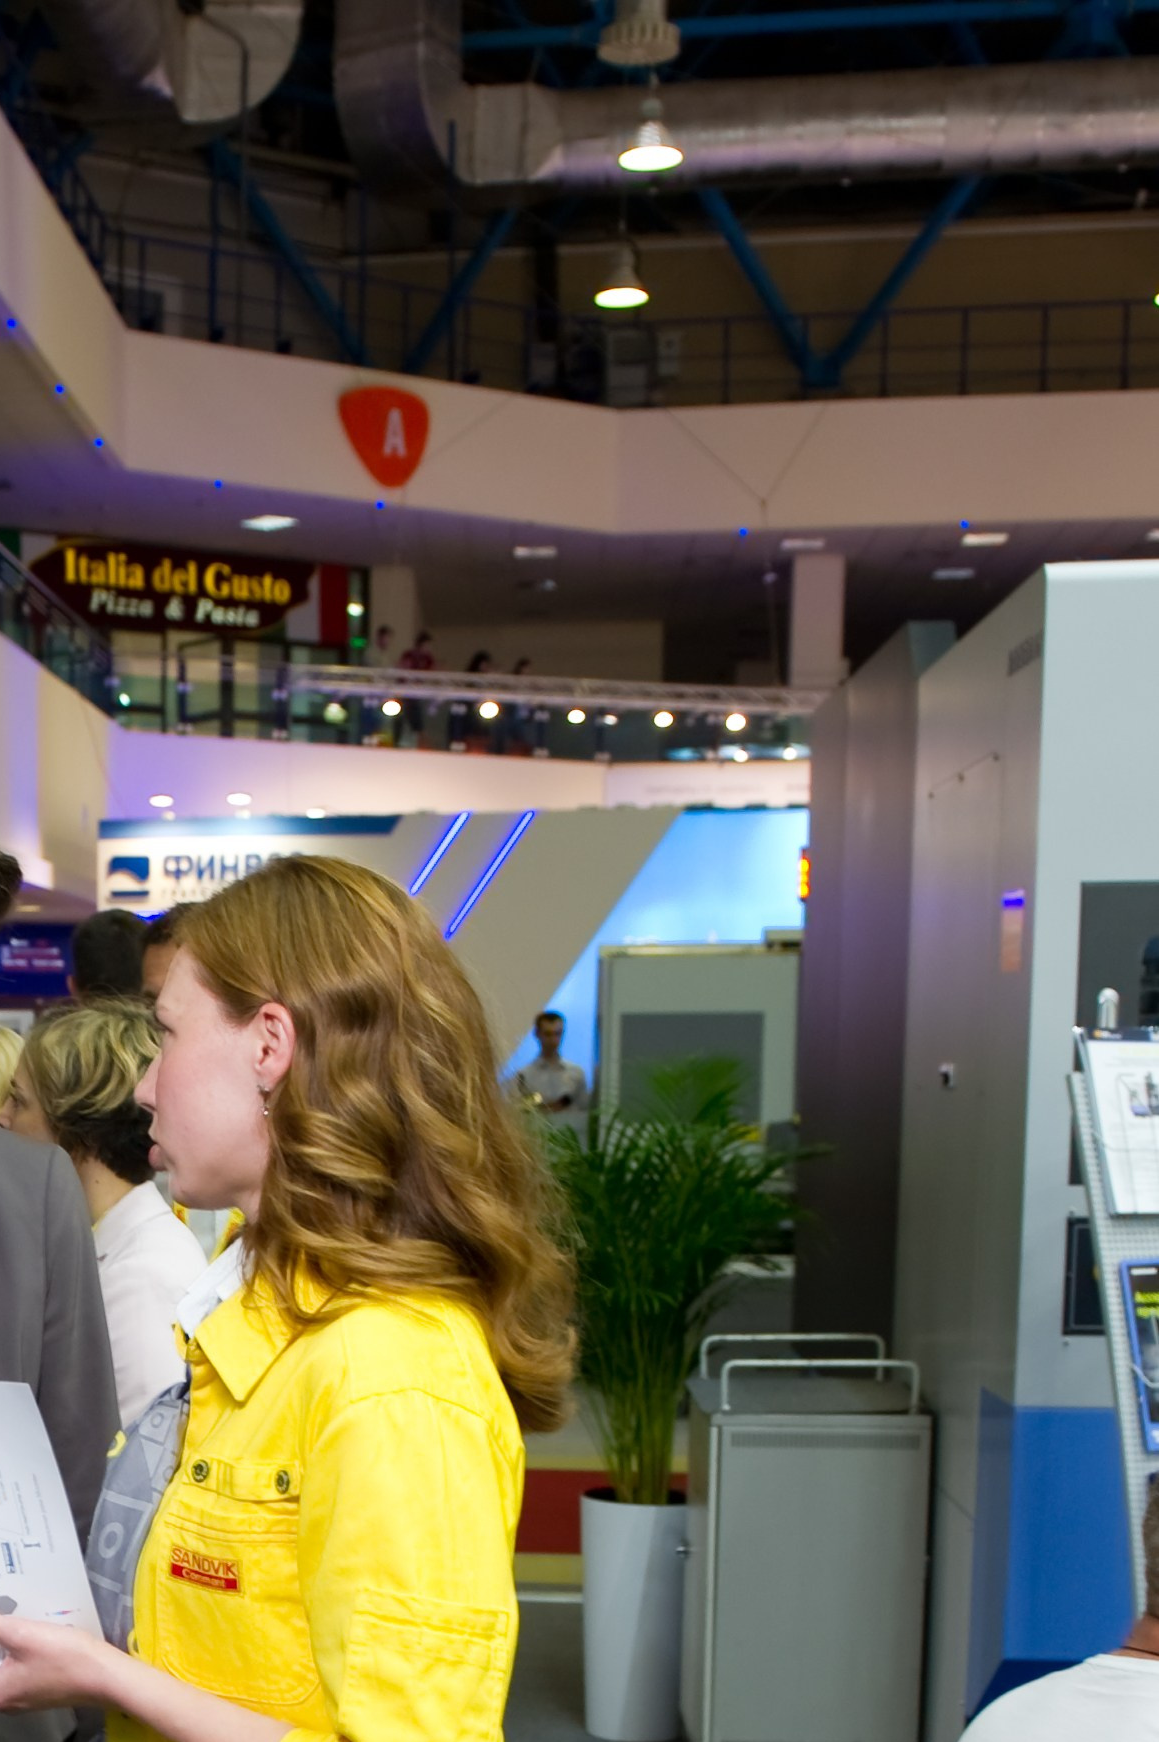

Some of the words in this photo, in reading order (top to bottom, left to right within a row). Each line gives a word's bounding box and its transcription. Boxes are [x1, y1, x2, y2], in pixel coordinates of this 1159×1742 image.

[382, 406, 408, 459] A
[63, 547, 146, 590] Italia
[151, 557, 199, 595] del
[203, 562, 292, 605] Gusto
[89, 587, 155, 618] Pizza
[163, 596, 185, 620] &
[194, 597, 261, 628] Pasta
[163, 852, 304, 881] ФИНВ
[170, 1547, 238, 1578] SANDVIK
